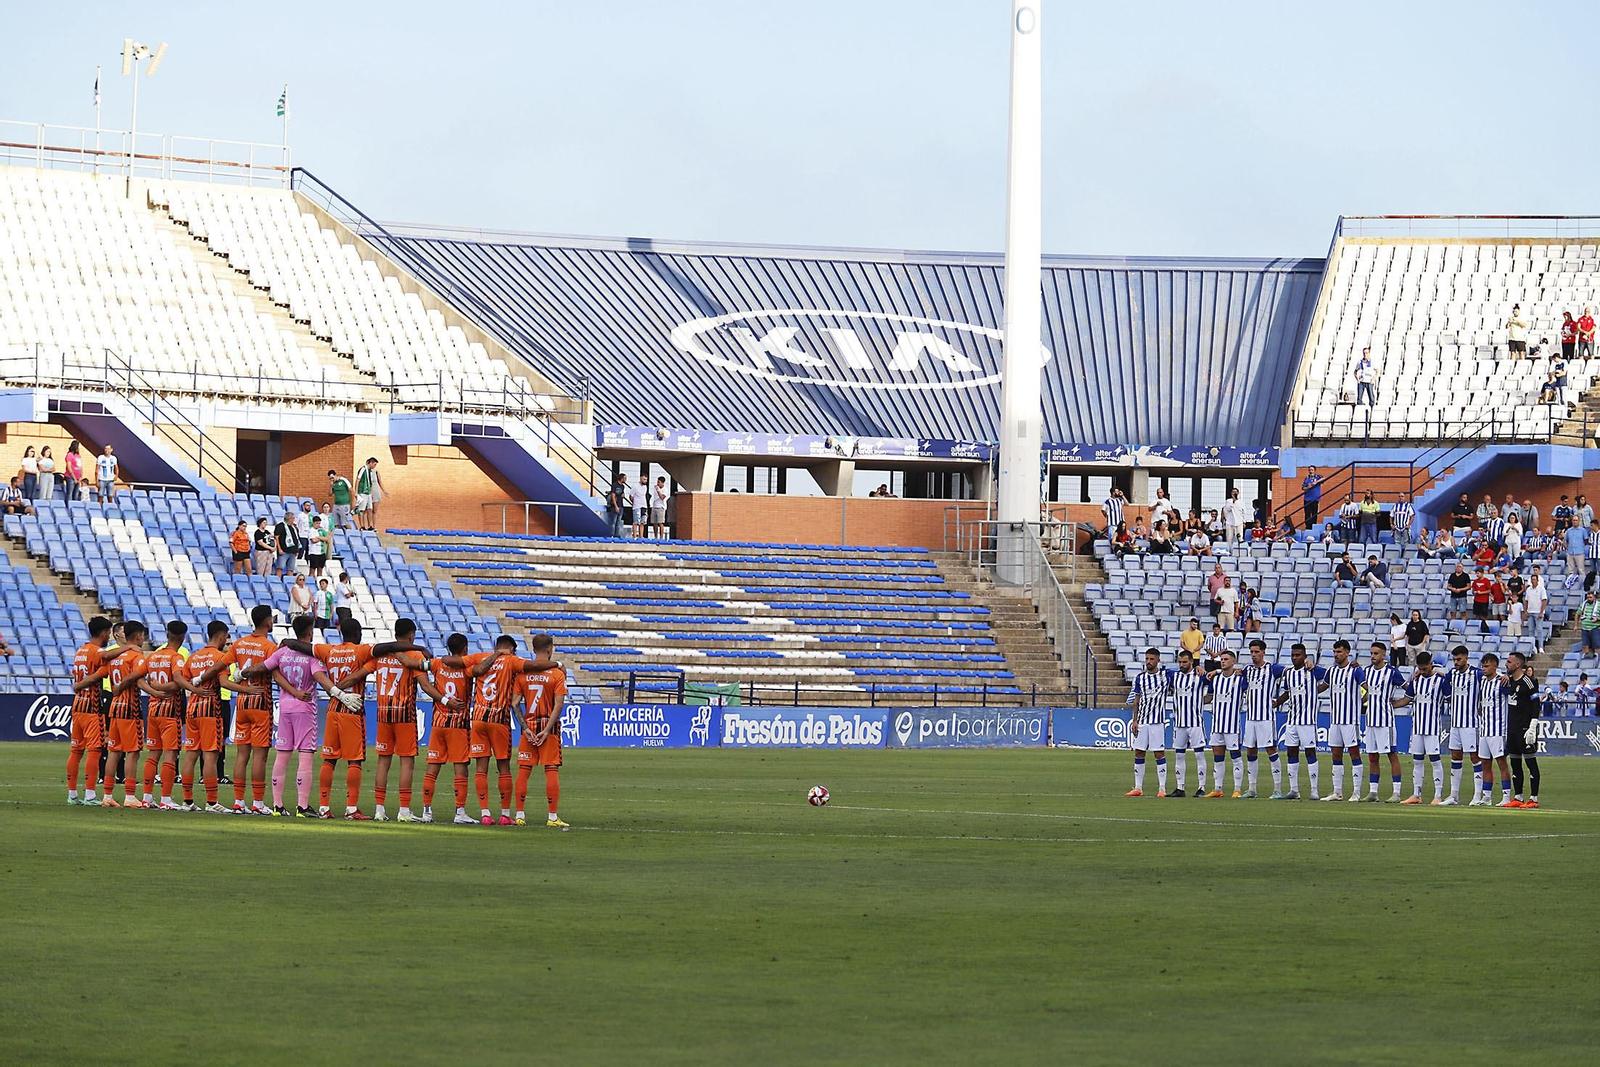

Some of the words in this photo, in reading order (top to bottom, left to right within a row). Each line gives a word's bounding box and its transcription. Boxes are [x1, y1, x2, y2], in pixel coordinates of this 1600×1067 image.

[378, 667, 404, 697] 17
[482, 673, 498, 701] 6
[526, 674, 549, 683] LOREN
[528, 684, 544, 714] 7
[603, 705, 664, 722] TAPICERÍA
[603, 723, 670, 737] RAIMUNDO
[723, 713, 798, 744] Fresón
[800, 713, 827, 745] de
[827, 714, 883, 745] Palos
[919, 712, 1042, 742] palparking
[1537, 720, 1578, 739] RAL
[643, 739, 665, 747] HUELVA
